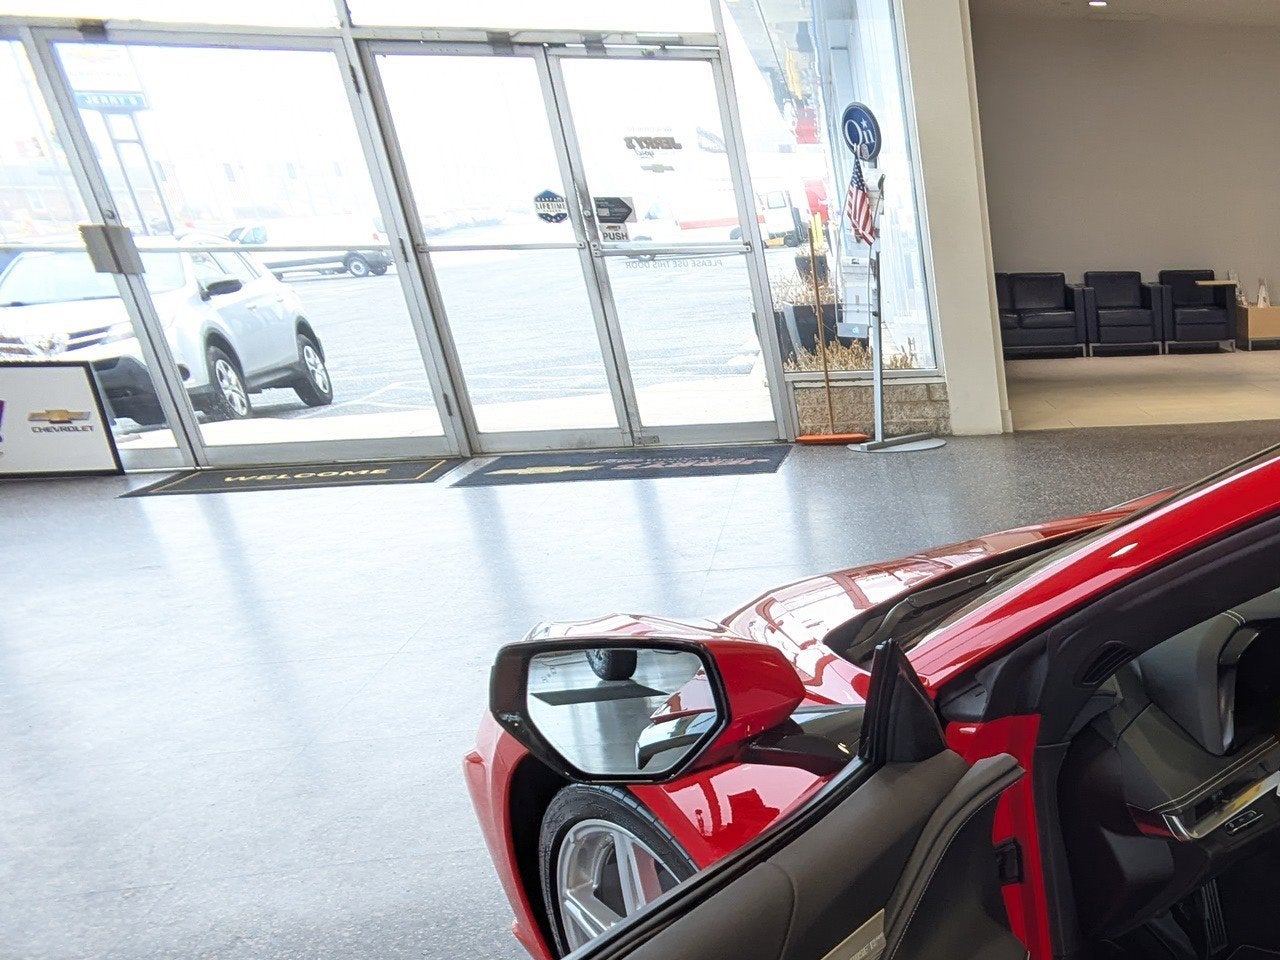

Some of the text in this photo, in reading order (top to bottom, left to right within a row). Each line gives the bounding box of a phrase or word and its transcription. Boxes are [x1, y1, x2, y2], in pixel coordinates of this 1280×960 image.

[535, 203, 566, 211] LIFETIME
[603, 232, 628, 241] PUSH
[31, 425, 95, 434] CHEVROLET
[224, 468, 391, 483] WELCOME
